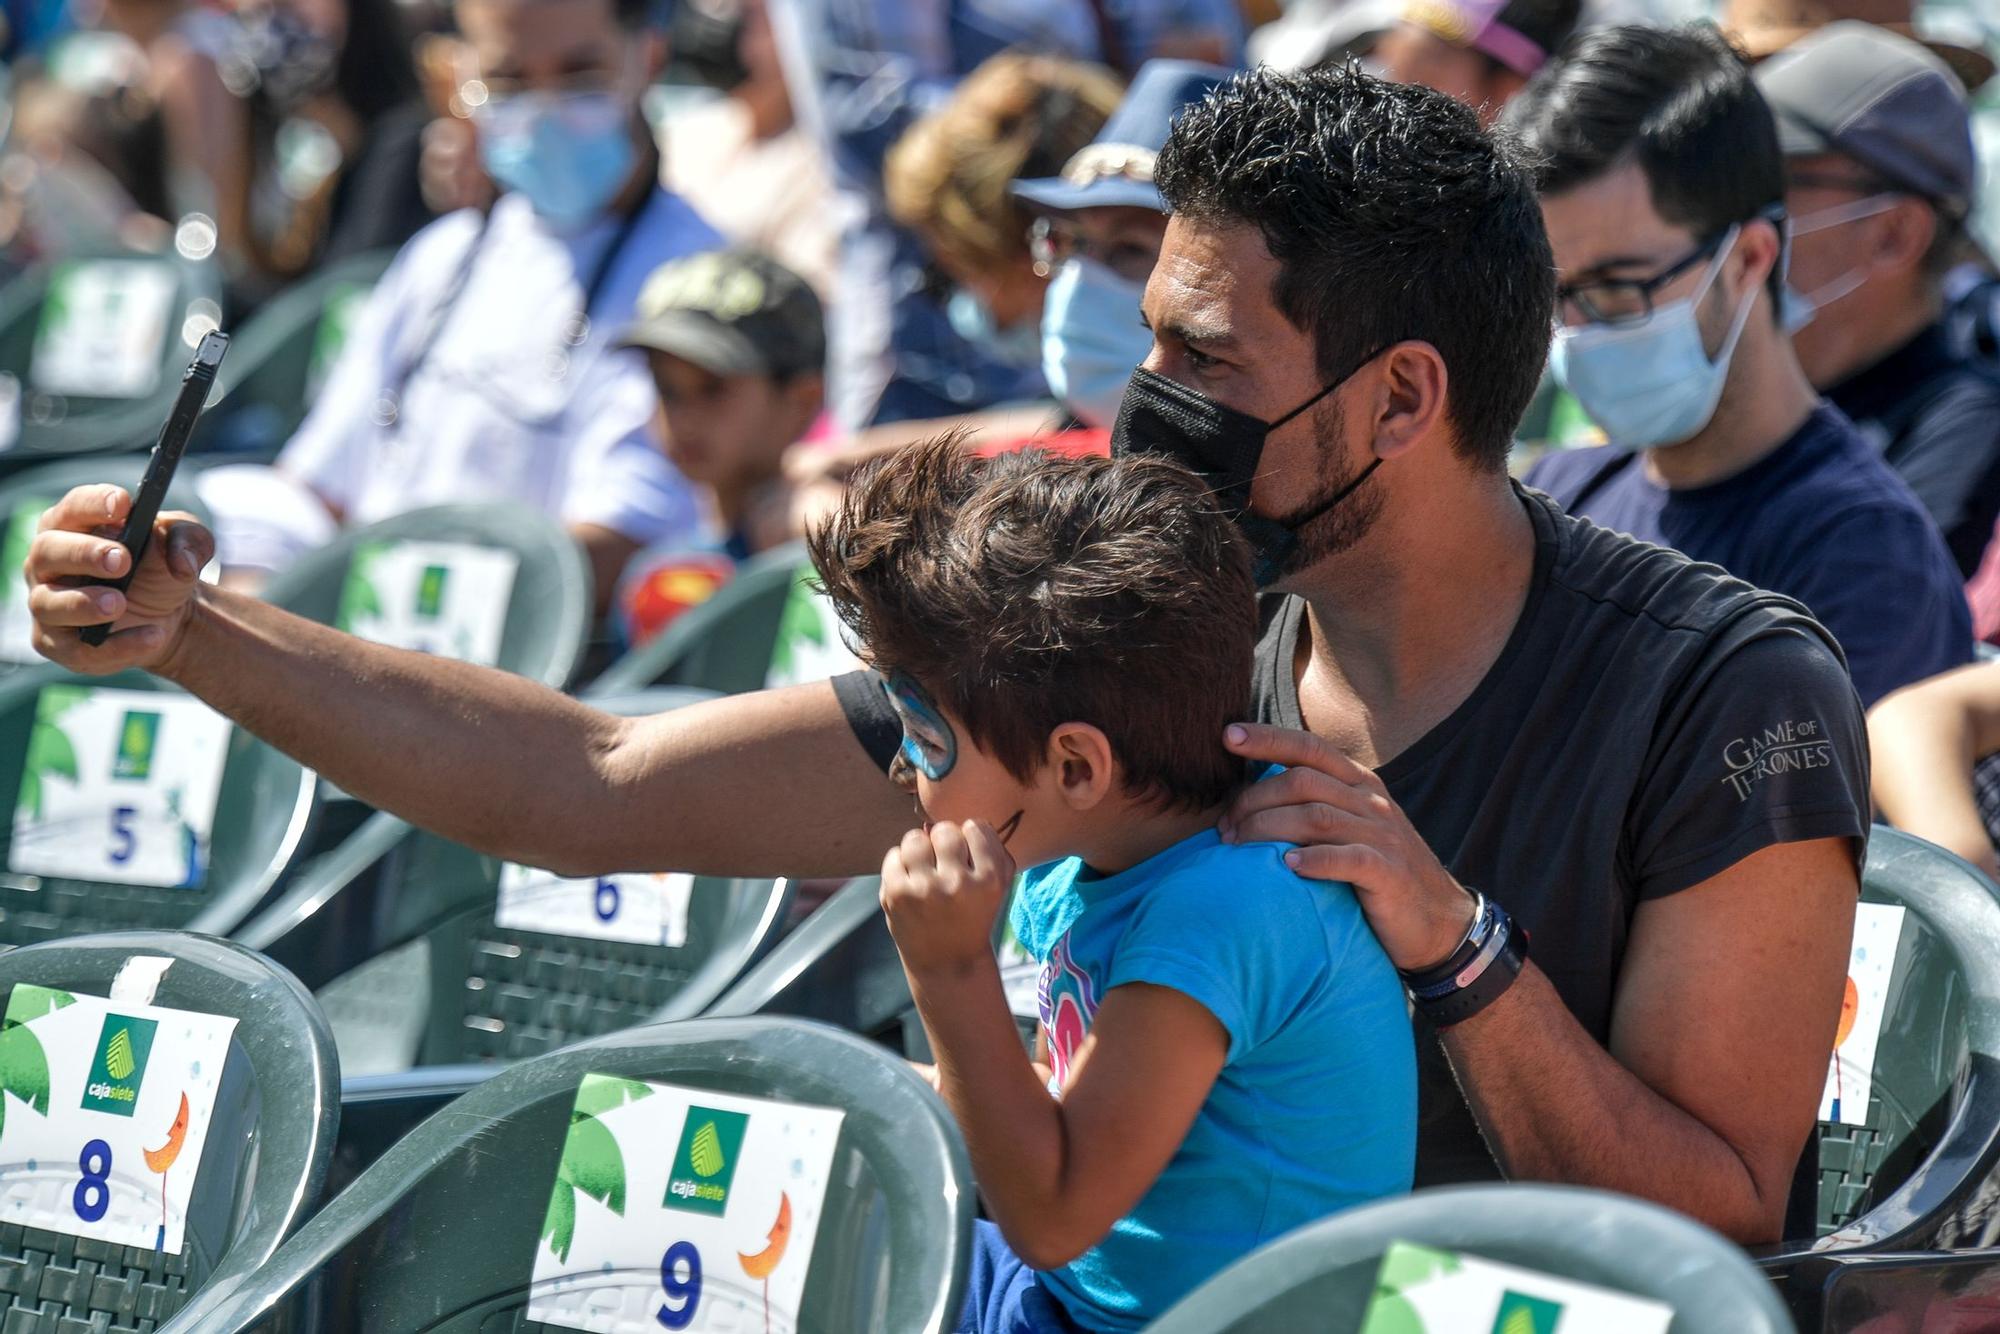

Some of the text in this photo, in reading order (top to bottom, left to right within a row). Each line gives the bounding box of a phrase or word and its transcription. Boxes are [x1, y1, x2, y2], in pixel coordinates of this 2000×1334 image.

[1721, 745, 1831, 802] THRONES
[1723, 720, 1817, 770] GAME OF
[108, 804, 138, 866] 5
[88, 1082, 135, 1102] cajasiete
[73, 1139, 112, 1223] 8
[671, 1180, 725, 1201] cajasiete
[656, 1240, 703, 1331] 9
